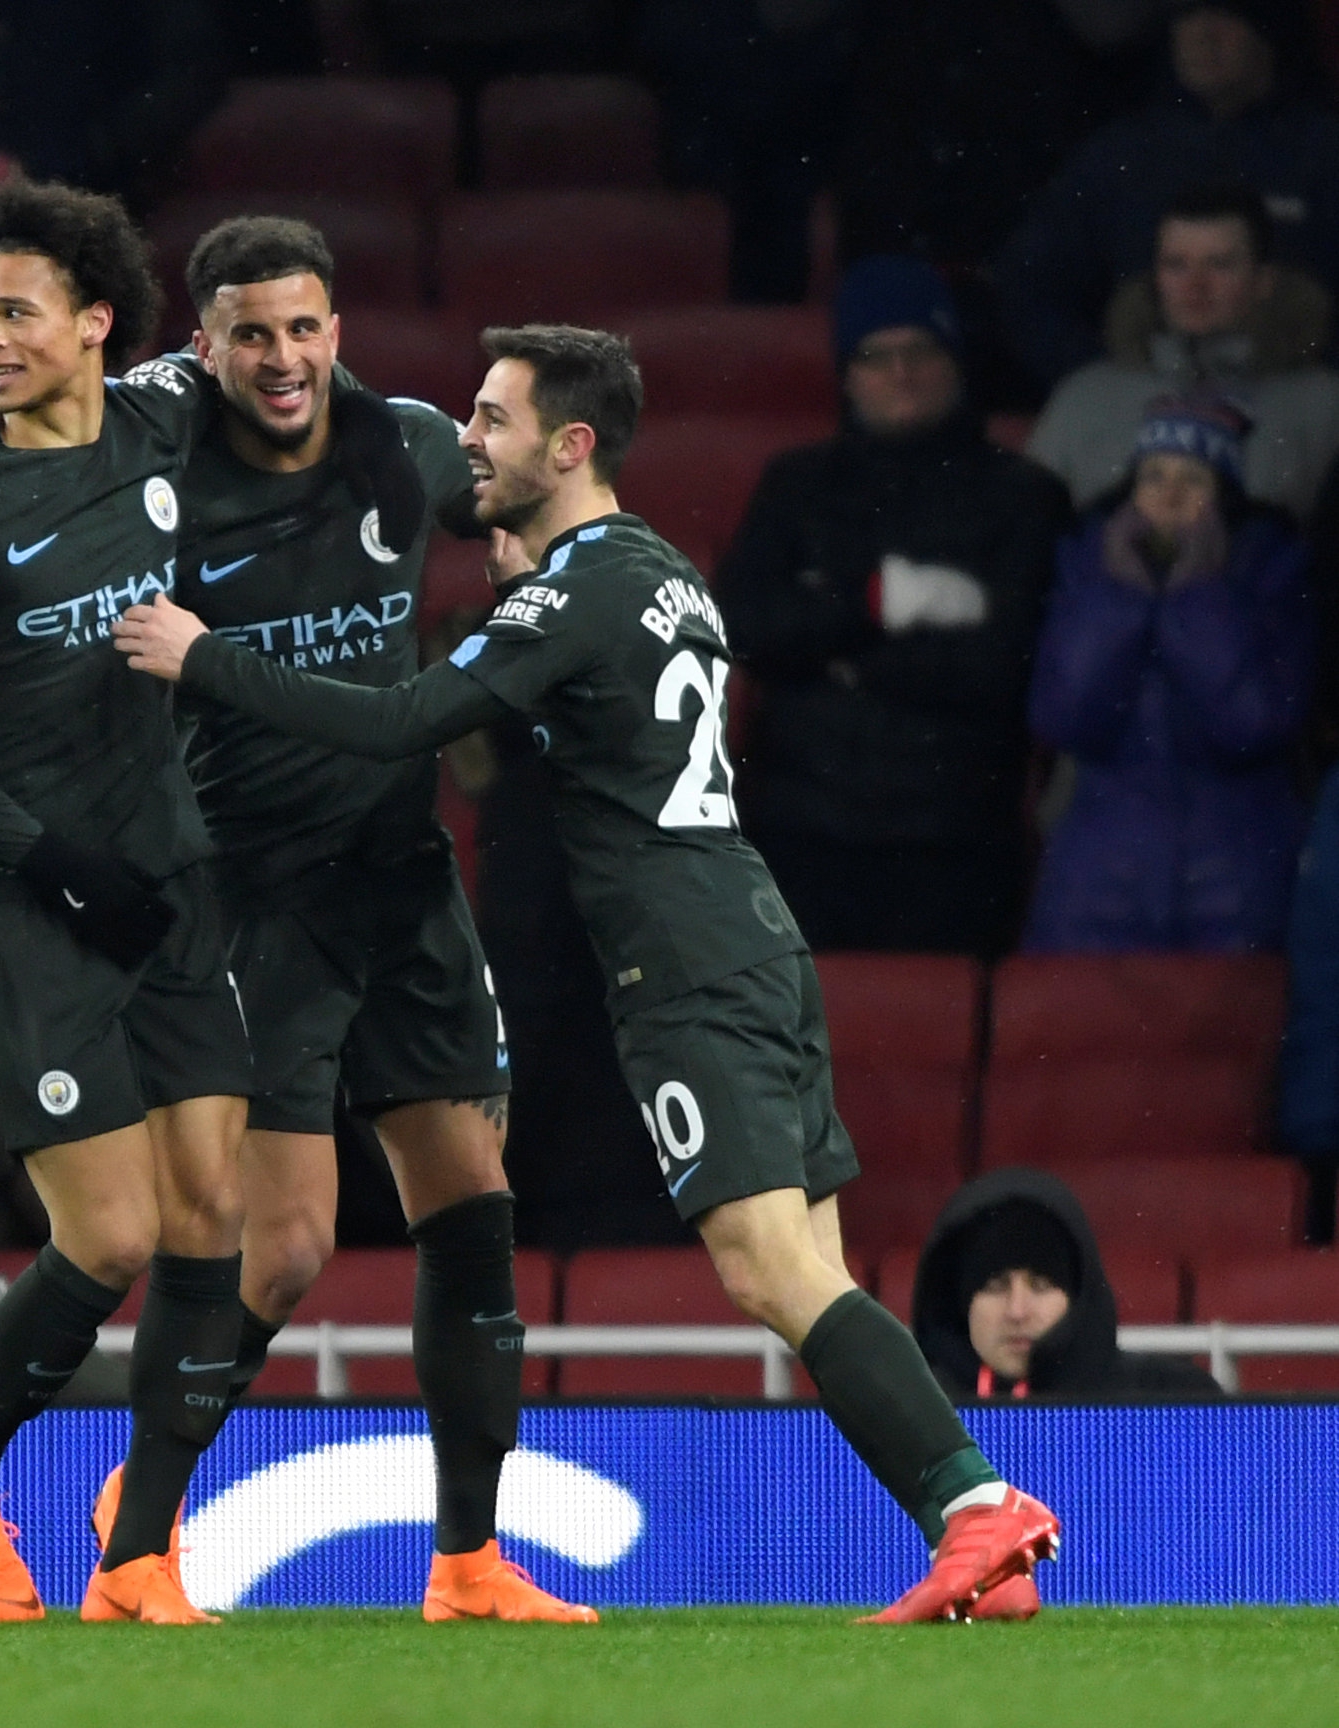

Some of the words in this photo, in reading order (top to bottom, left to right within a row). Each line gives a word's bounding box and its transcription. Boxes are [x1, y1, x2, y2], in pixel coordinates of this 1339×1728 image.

[639, 577, 728, 645] BERNAR
[279, 633, 385, 669] IRWAYS
[654, 650, 741, 829] 2
[641, 1080, 705, 1176] 0
[495, 1336, 525, 1351] CIT
